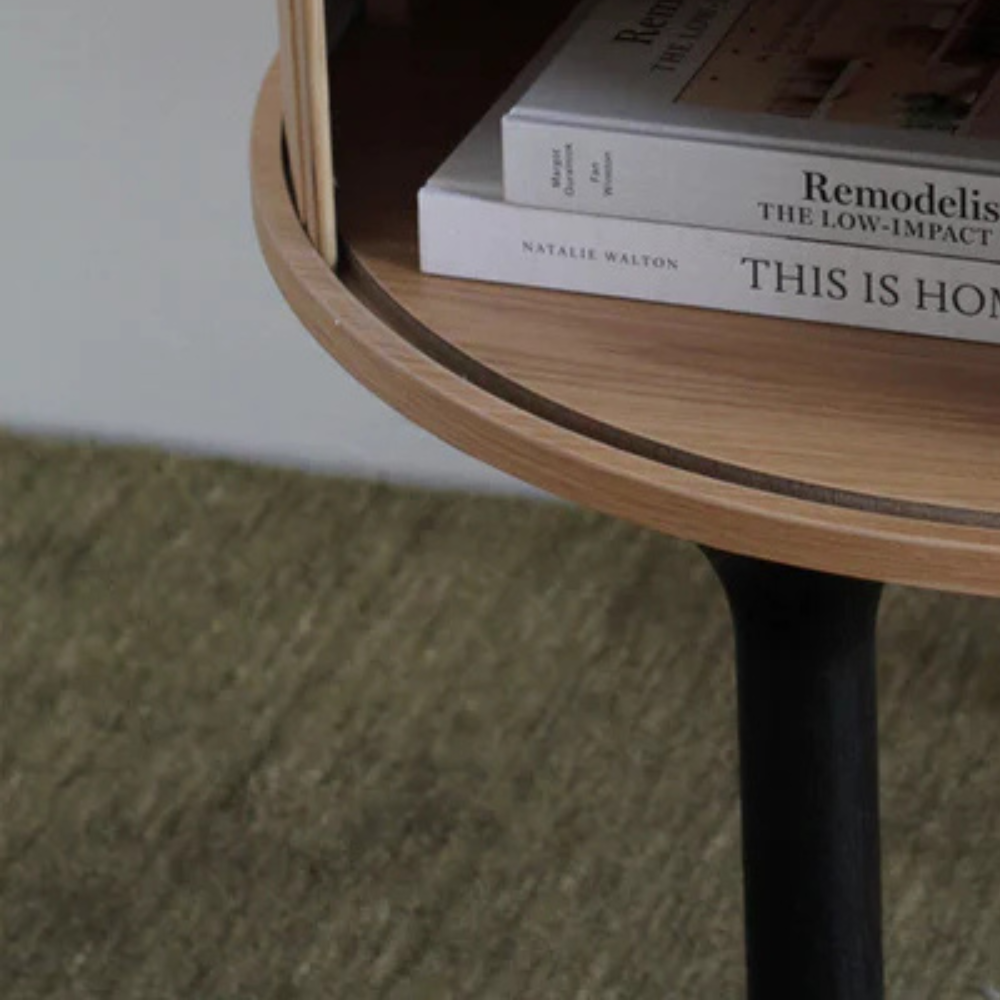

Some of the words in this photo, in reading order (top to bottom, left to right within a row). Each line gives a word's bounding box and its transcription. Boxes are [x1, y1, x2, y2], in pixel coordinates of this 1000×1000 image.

[757, 201, 815, 226] THE
[822, 210, 992, 246] LOW-IMPACT
[522, 240, 598, 261] NATALIE
[604, 251, 679, 270] WALTON
[740, 257, 848, 301] THIS
[862, 272, 900, 307] IS
